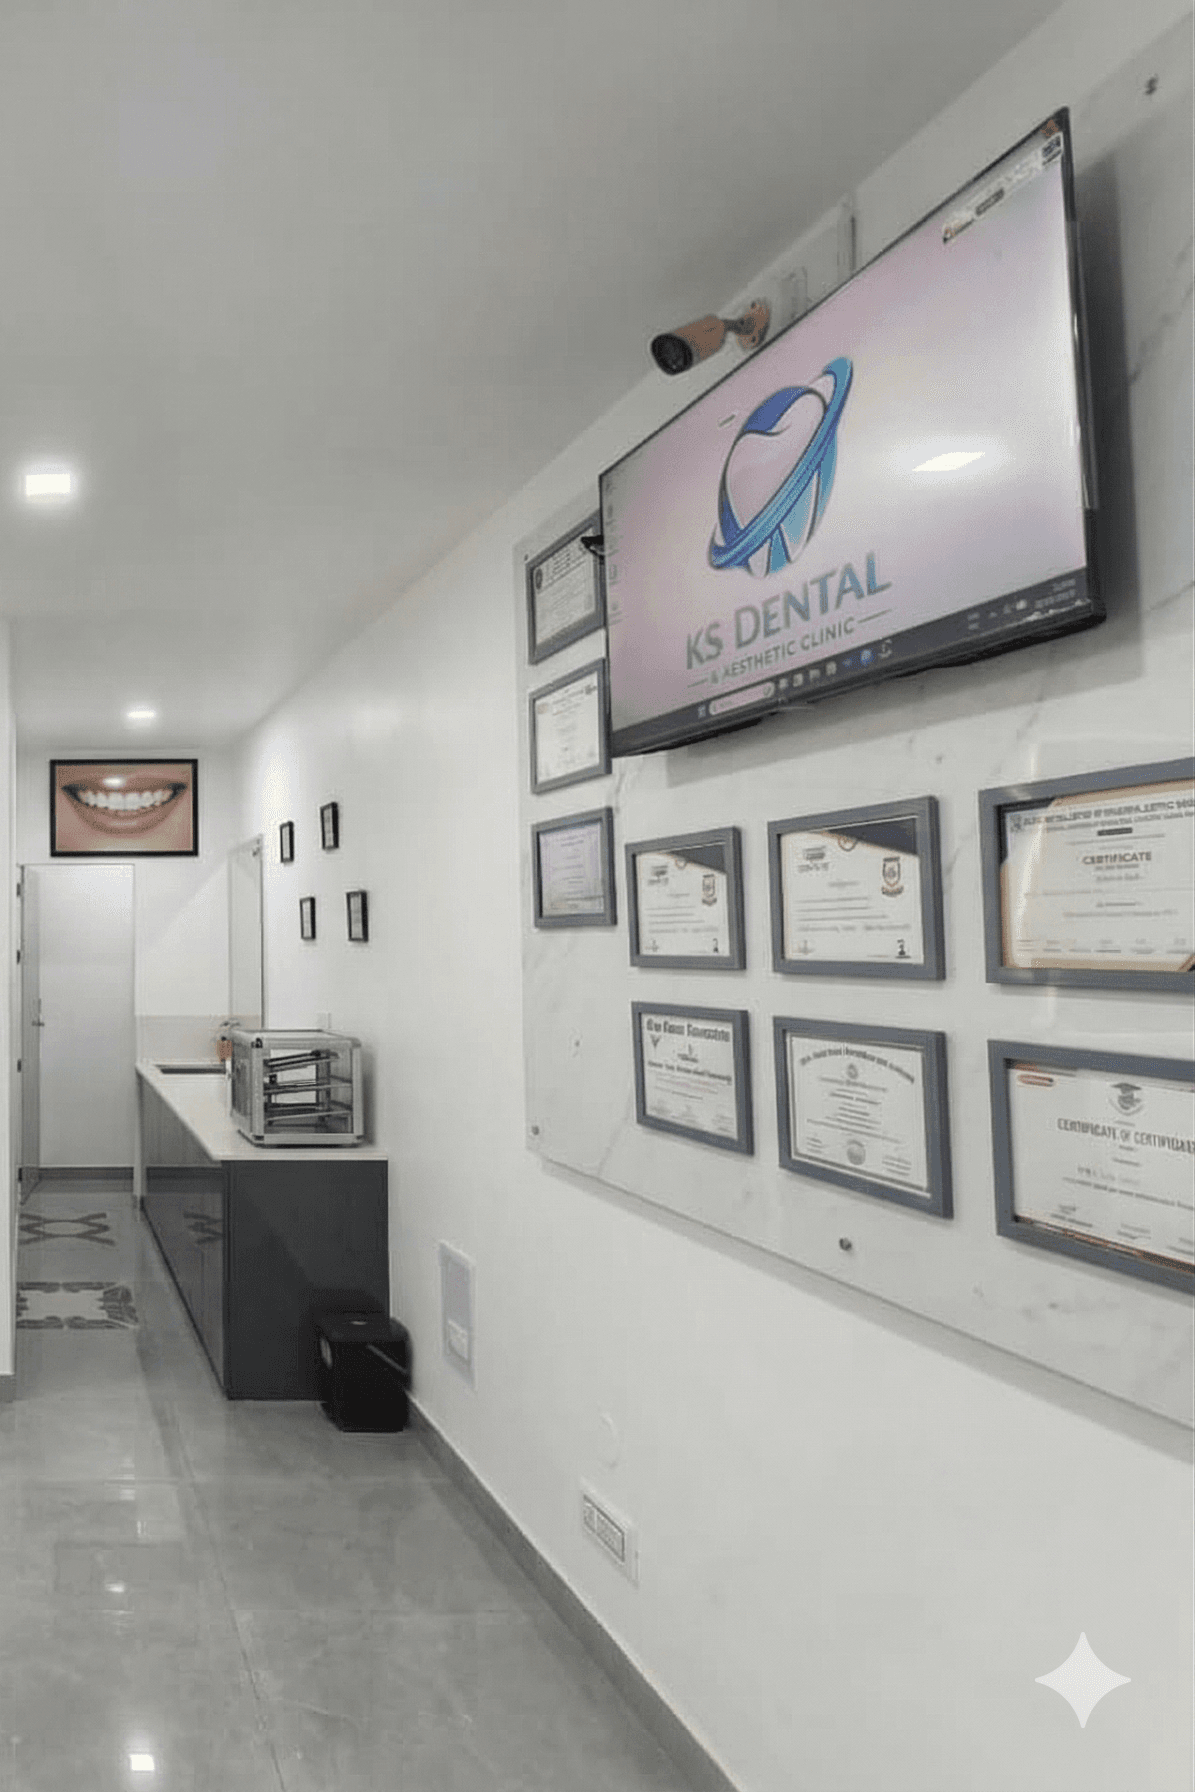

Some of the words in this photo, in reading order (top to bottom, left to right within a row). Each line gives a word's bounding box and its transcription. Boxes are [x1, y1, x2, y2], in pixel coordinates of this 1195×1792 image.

[686, 622, 723, 670] KS
[735, 551, 892, 649] DENTAL
[724, 640, 796, 680] AESTHETIC
[801, 617, 855, 651] CLINIC
